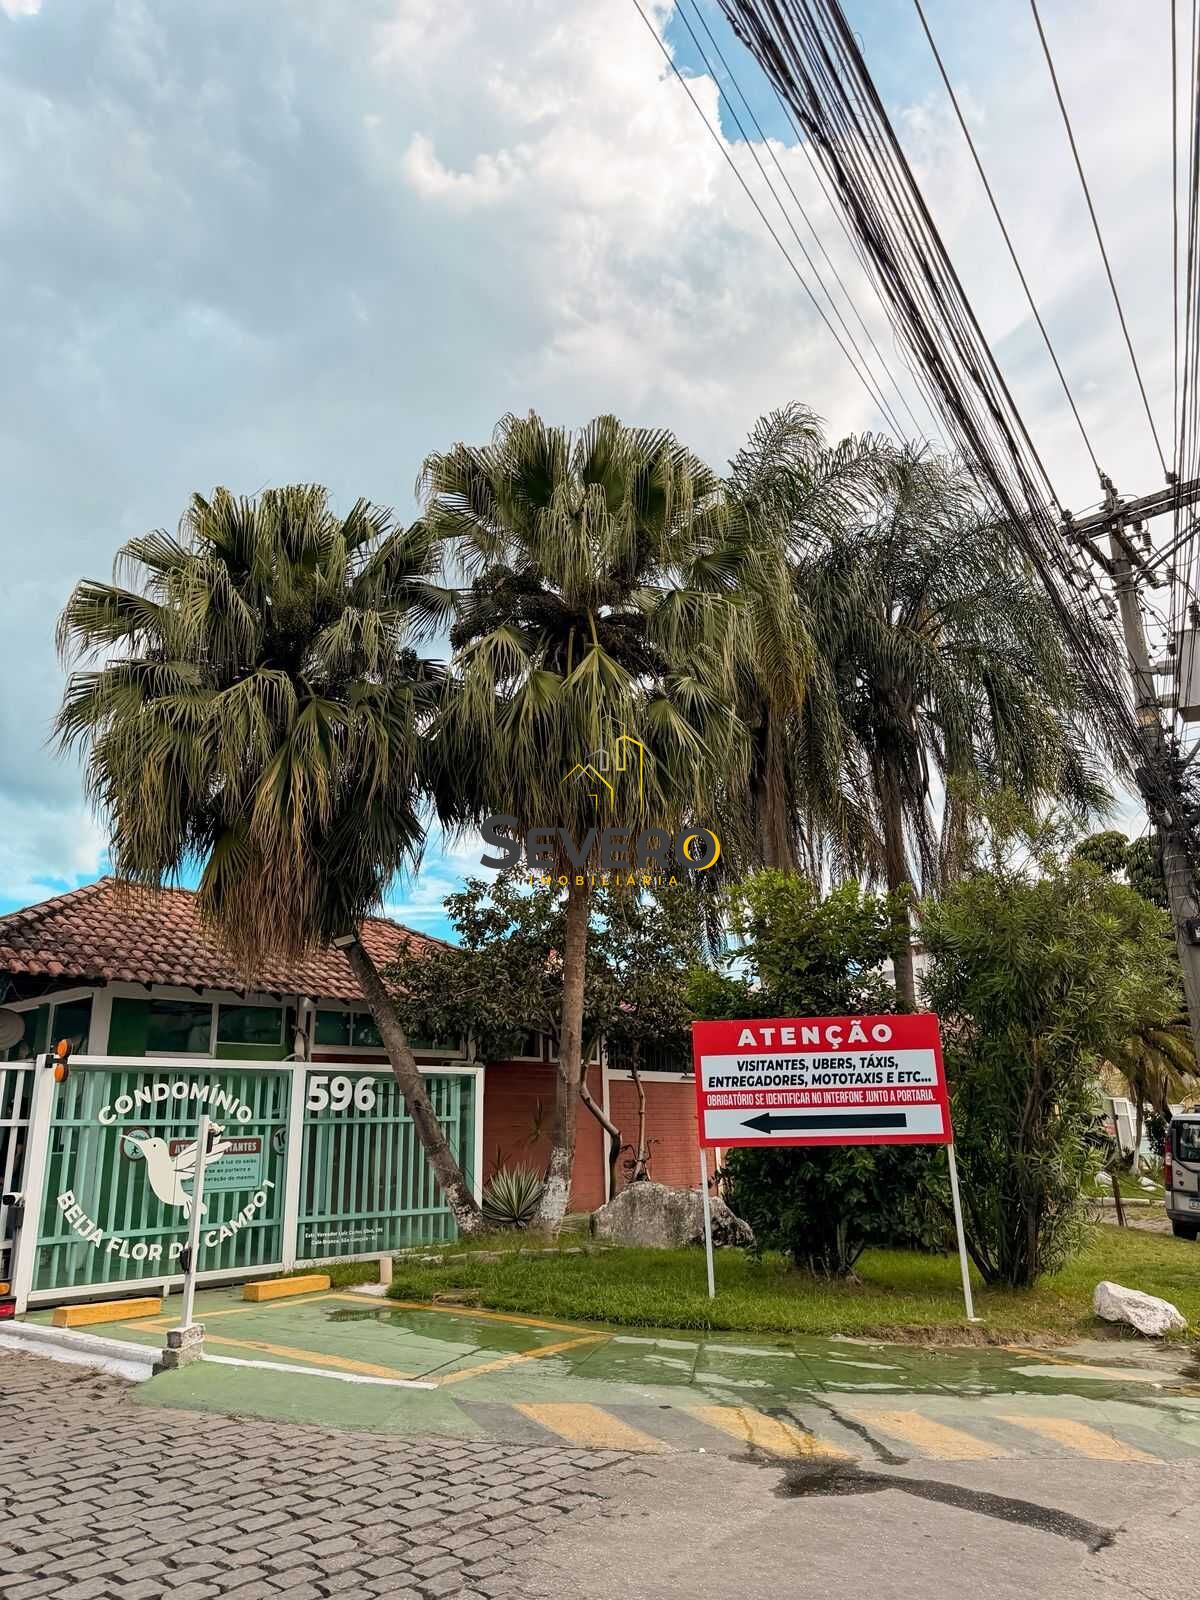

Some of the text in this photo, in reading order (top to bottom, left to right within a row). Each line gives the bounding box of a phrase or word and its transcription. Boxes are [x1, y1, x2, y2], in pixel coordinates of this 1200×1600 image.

[737, 1020, 893, 1050] ATENÇÃO
[737, 1054, 898, 1073] VISITANTES, UBERS, TÁXIS,
[306, 1076, 376, 1111] 596
[708, 1071, 932, 1088] ENTREGADORES, MOTOTAXIS E ETC...
[98, 1082, 252, 1124] CONDOMÍNIO
[706, 1088, 936, 1106] OBRIGATÓRIO SE IDENTIFICAR NO INTERFONE JUNTO A PORTARIA.
[57, 1190, 103, 1248] BEIJA
[106, 1236, 161, 1260] FLOR
[204, 1191, 268, 1248] CAMPO
